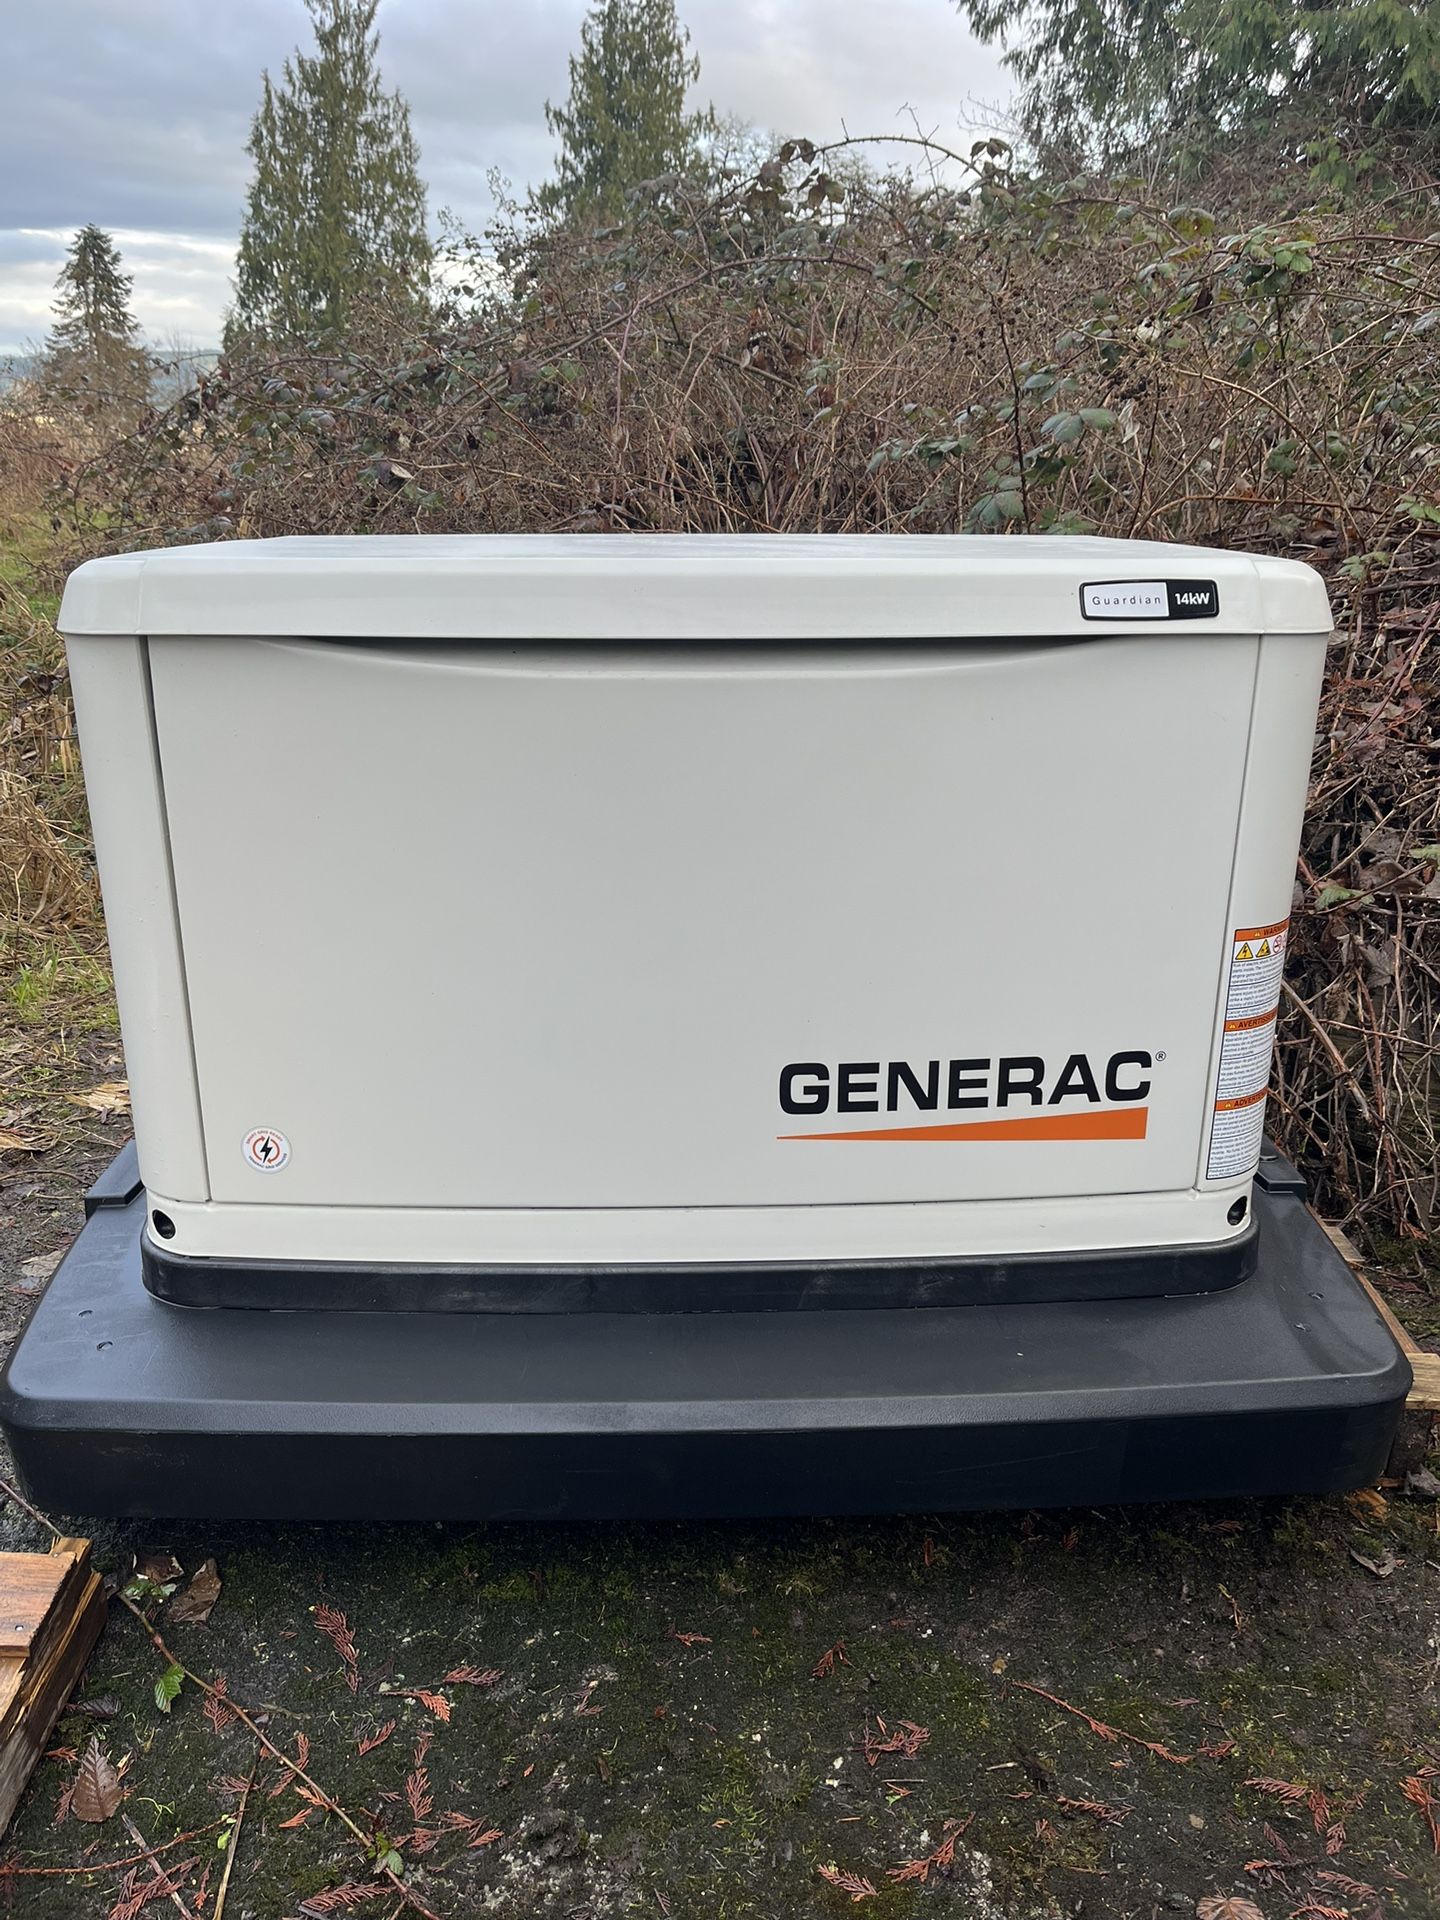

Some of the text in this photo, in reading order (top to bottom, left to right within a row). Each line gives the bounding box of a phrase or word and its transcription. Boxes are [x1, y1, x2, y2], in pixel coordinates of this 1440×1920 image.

[1092, 592, 1210, 606] Guardian 14kW
[779, 1050, 1152, 1115] GENERAC
